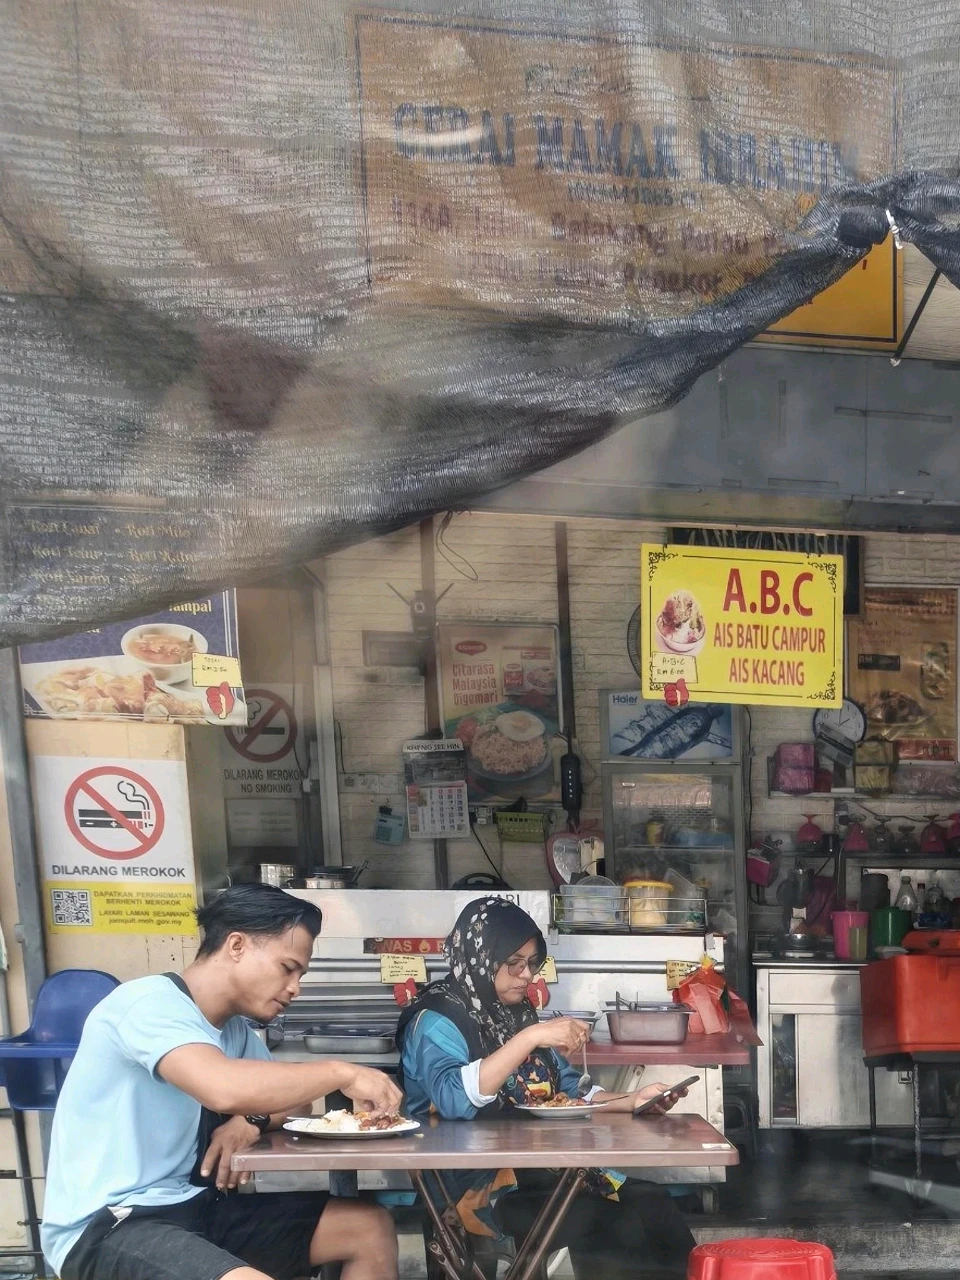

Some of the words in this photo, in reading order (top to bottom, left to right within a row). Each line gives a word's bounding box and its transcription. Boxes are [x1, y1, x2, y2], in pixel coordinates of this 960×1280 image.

[723, 568, 814, 617] A.B.C
[714, 622, 734, 648] AIS
[736, 623, 769, 649] BATU
[772, 625, 826, 653] CAMPUR
[858, 656, 873, 664] RM
[452, 664, 495, 678] Citarasa
[729, 657, 749, 683] AIS
[752, 659, 805, 686] KACANG
[452, 678, 497, 692] Malaysia
[454, 691, 498, 706] Digemari
[613, 694, 638, 705] Haier
[224, 768, 264, 781] DILARANG
[241, 783, 253, 793] NO
[255, 783, 292, 793] SMOKING
[52, 864, 118, 876] DILARANG
[122, 866, 186, 878] MEROKOK
[94, 890, 134, 898] DAPATKAN
[136, 891, 192, 899] PERKHIDMATAN
[106, 898, 143, 906] BERHENTI
